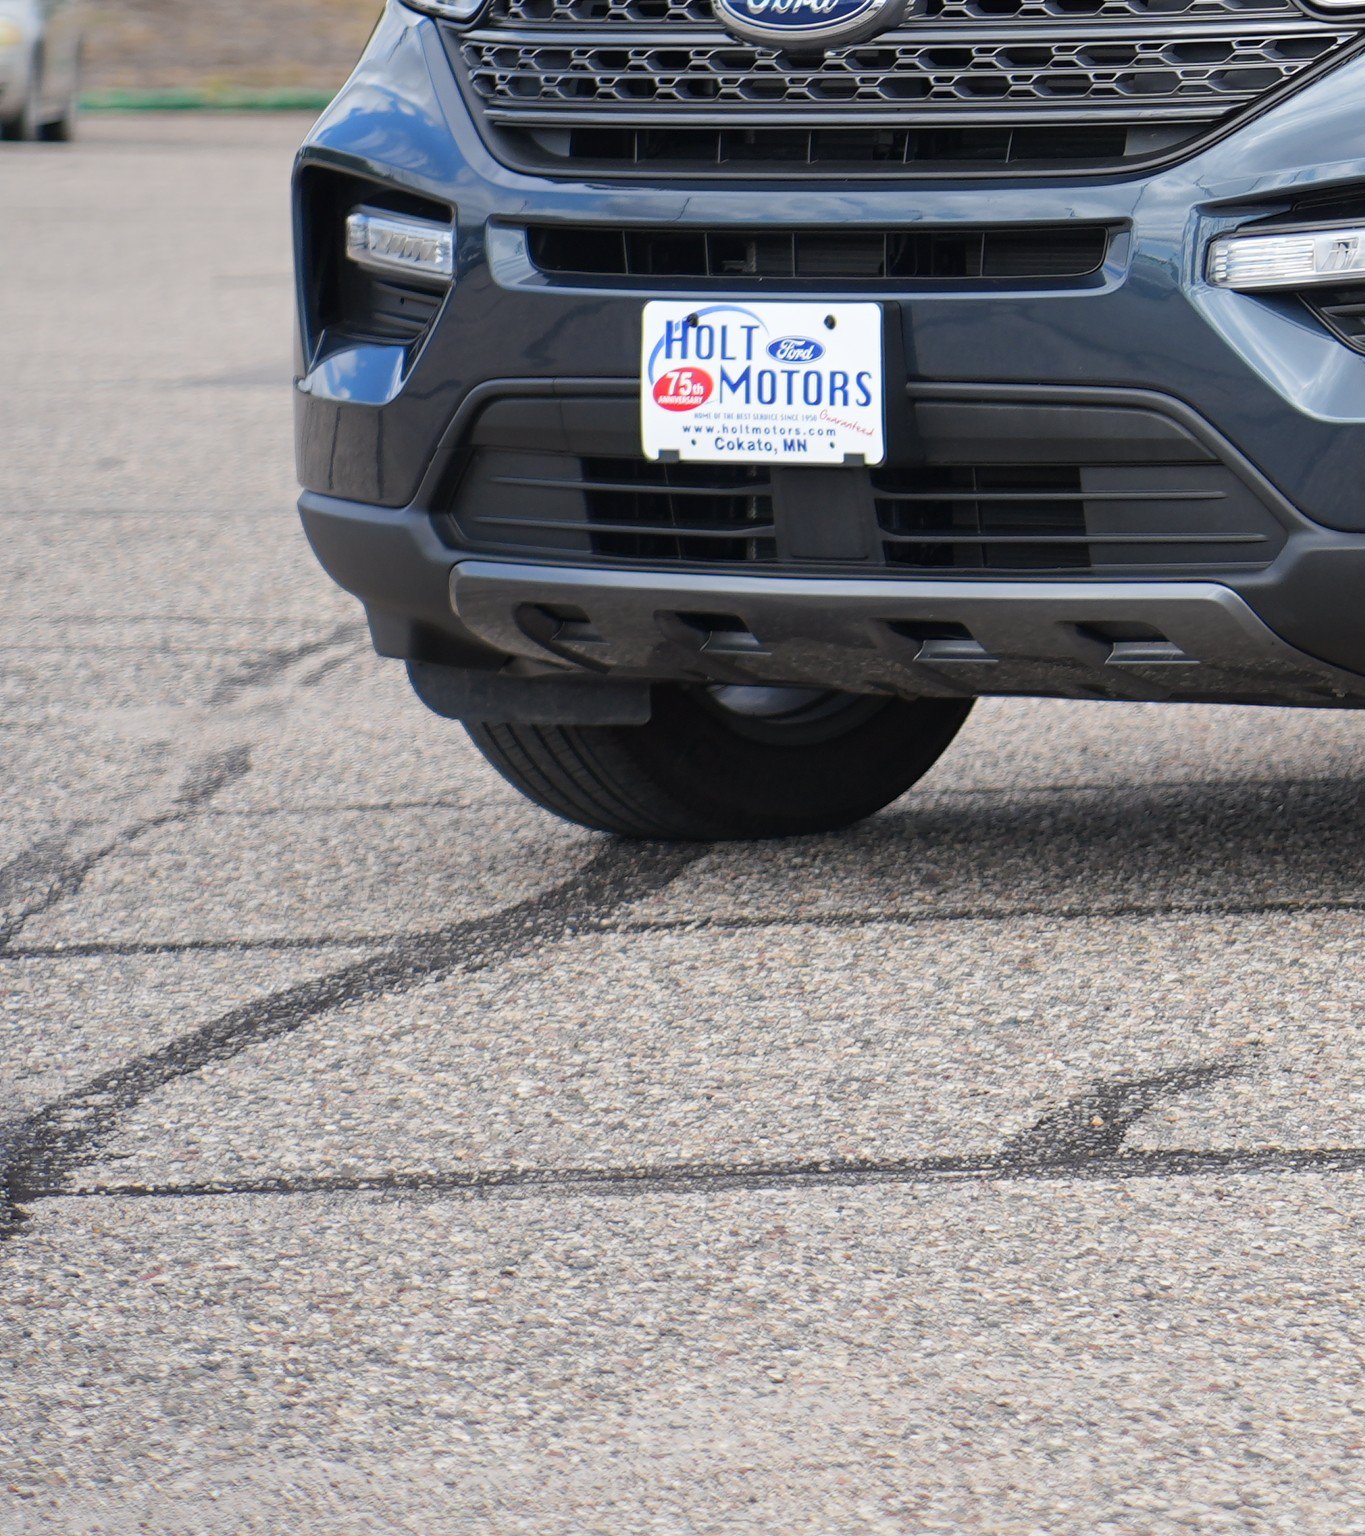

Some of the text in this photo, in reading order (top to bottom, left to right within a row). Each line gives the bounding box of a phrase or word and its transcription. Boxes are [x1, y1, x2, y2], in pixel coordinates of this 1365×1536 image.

[664, 320, 760, 361] HOLT
[776, 339, 815, 361] Ford
[666, 371, 705, 396] 75th
[719, 364, 873, 407] MOTORS
[657, 395, 705, 405] ANNIVERSARY
[694, 412, 712, 420] HOME
[736, 413, 751, 421] BEST
[780, 414, 799, 422] SINCE
[682, 424, 837, 436] www.holtmotors.com
[714, 437, 808, 455] Cokato, MN
